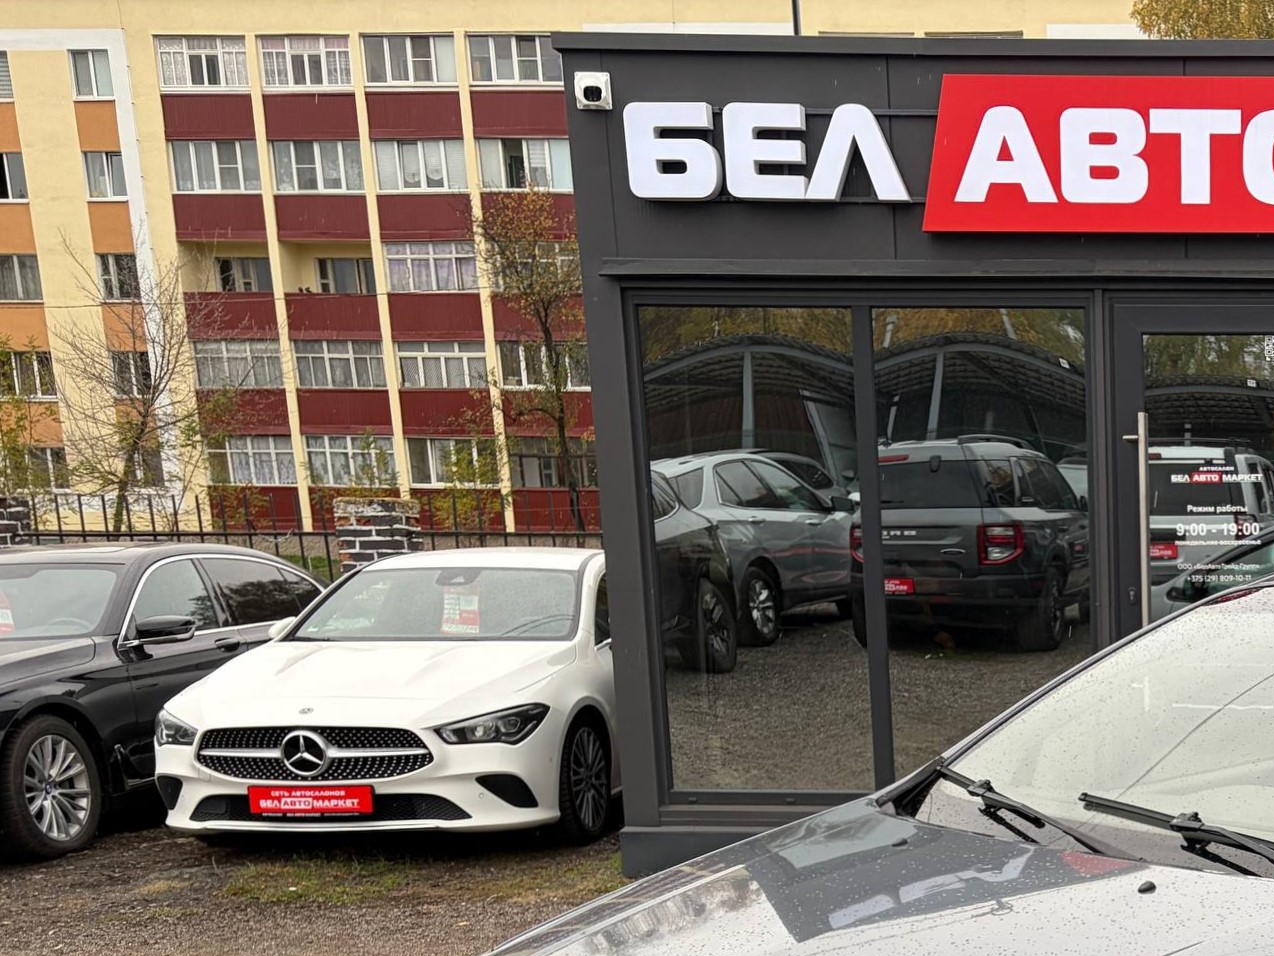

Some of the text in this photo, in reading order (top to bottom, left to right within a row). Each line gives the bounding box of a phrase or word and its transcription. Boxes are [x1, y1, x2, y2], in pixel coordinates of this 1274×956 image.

[623, 102, 911, 202] БЕЛ
[1171, 474, 1190, 483] БЕЛ
[1222, 473, 1263, 482] МАРКЕТ
[1217, 505, 1247, 513] работы
[1176, 523, 1206, 536] 9:00
[1223, 522, 1259, 536] 19:00
[260, 799, 359, 808] БЕЛ АВТО МАРКЕТ
